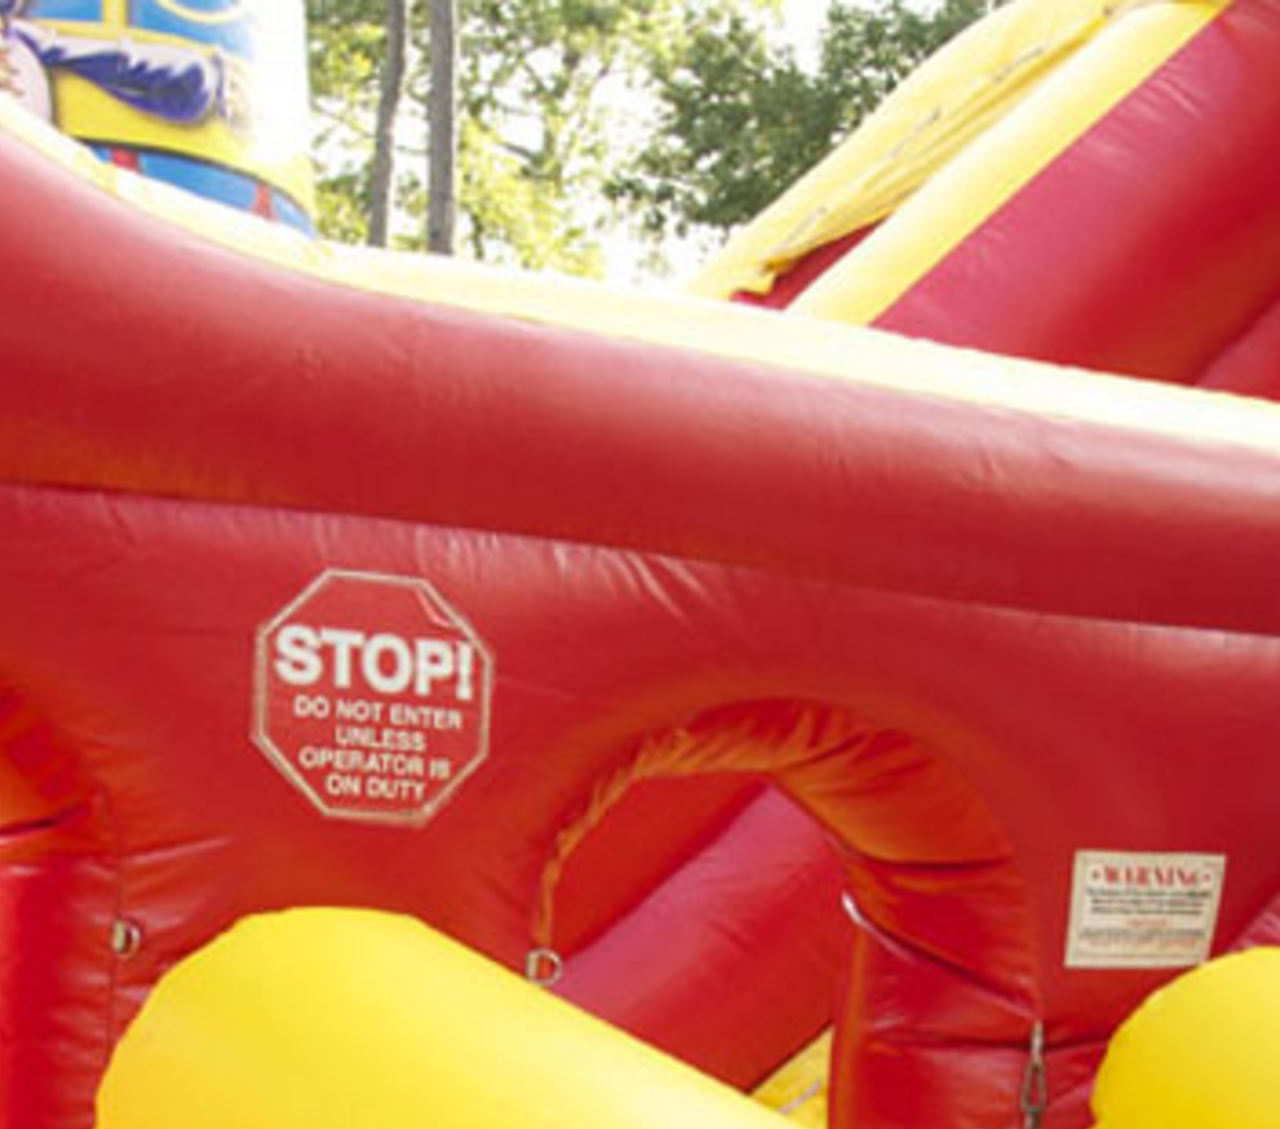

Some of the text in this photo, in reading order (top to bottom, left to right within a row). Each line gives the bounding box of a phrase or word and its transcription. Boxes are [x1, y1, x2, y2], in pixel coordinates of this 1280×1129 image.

[274, 623, 474, 701] STOP!
[293, 694, 463, 729] DO NOT ENTER
[334, 724, 426, 752] UNLESS
[298, 746, 451, 780] OPERATOR IS
[325, 774, 426, 801] ON DUTY
